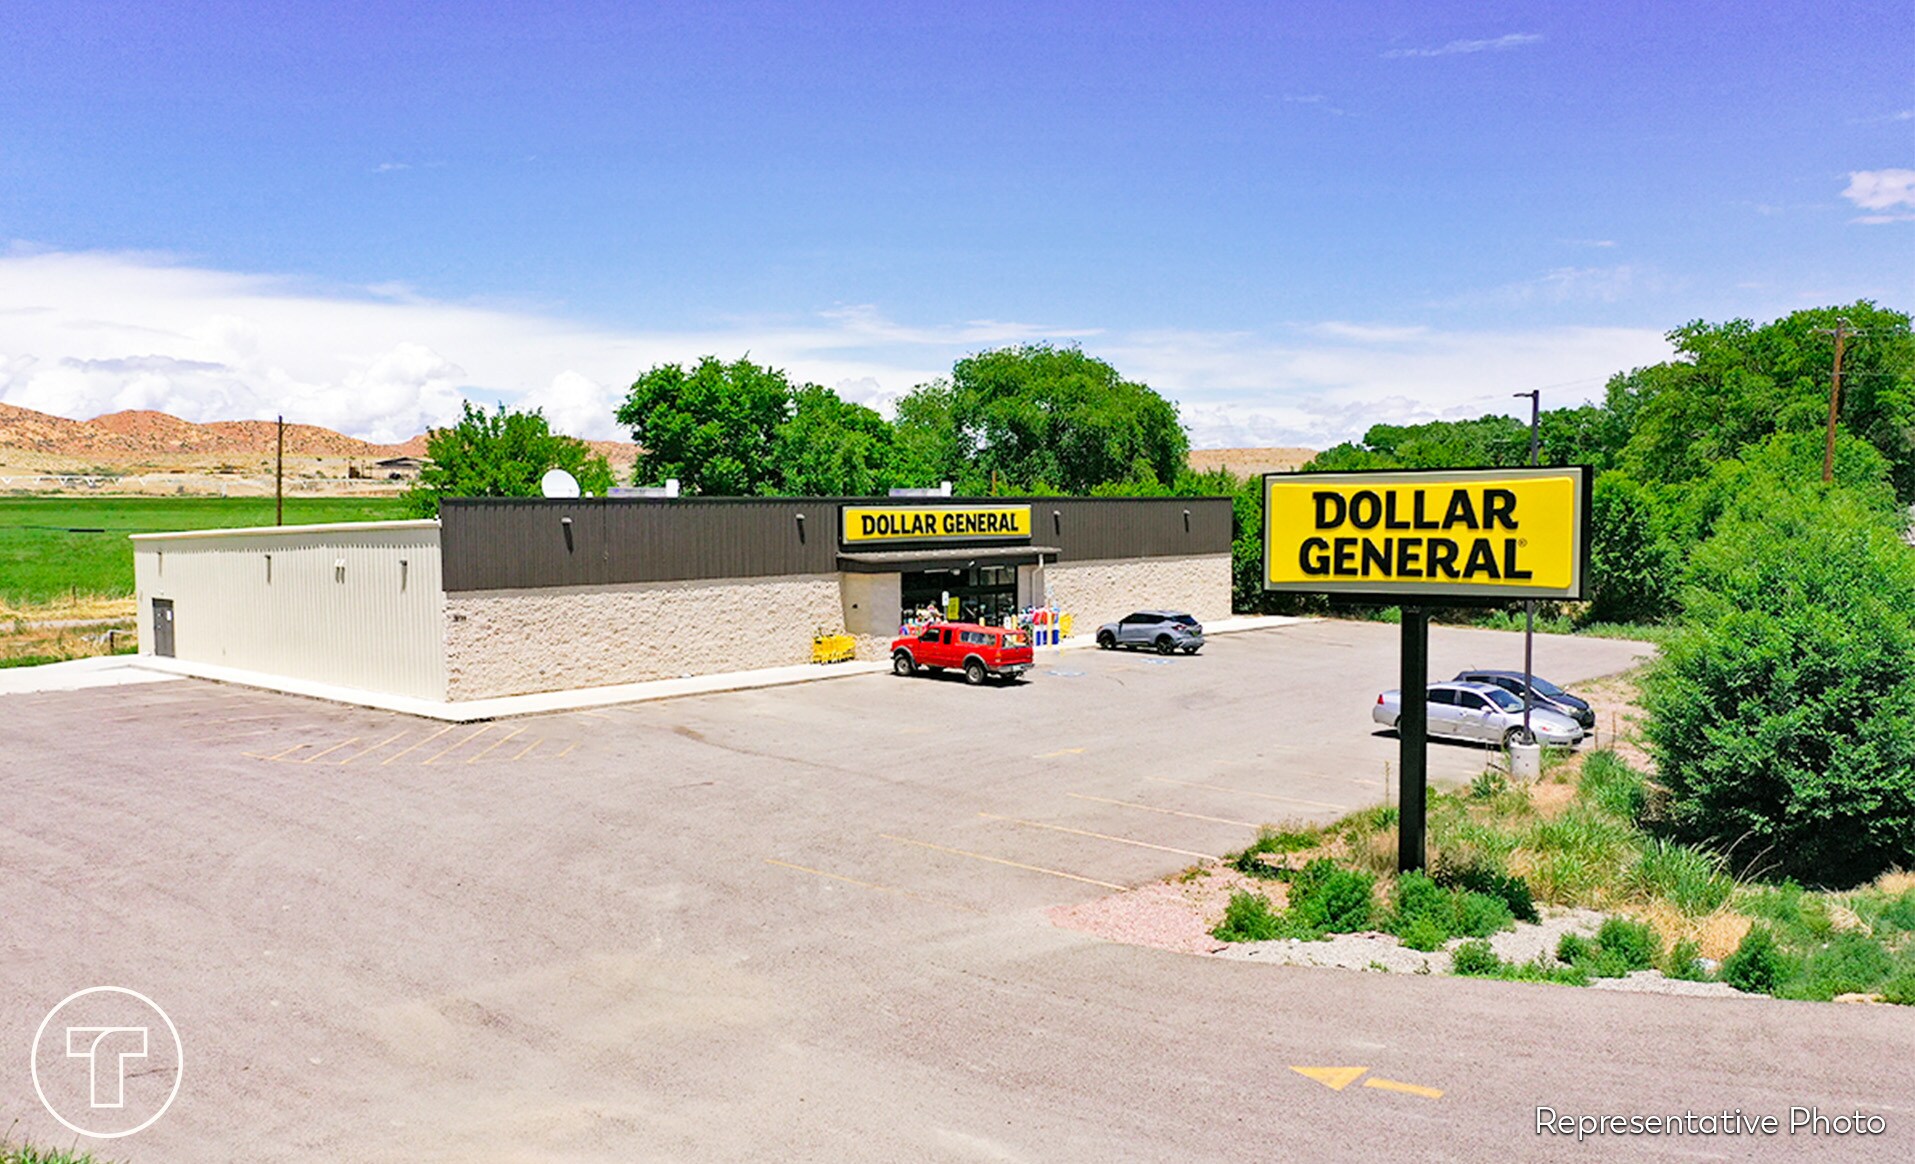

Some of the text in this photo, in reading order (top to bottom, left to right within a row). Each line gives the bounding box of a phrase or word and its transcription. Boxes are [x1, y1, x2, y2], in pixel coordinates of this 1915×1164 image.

[861, 512, 1019, 536] DOLLAR GENERAL
[1312, 488, 1520, 530] DOLLAR
